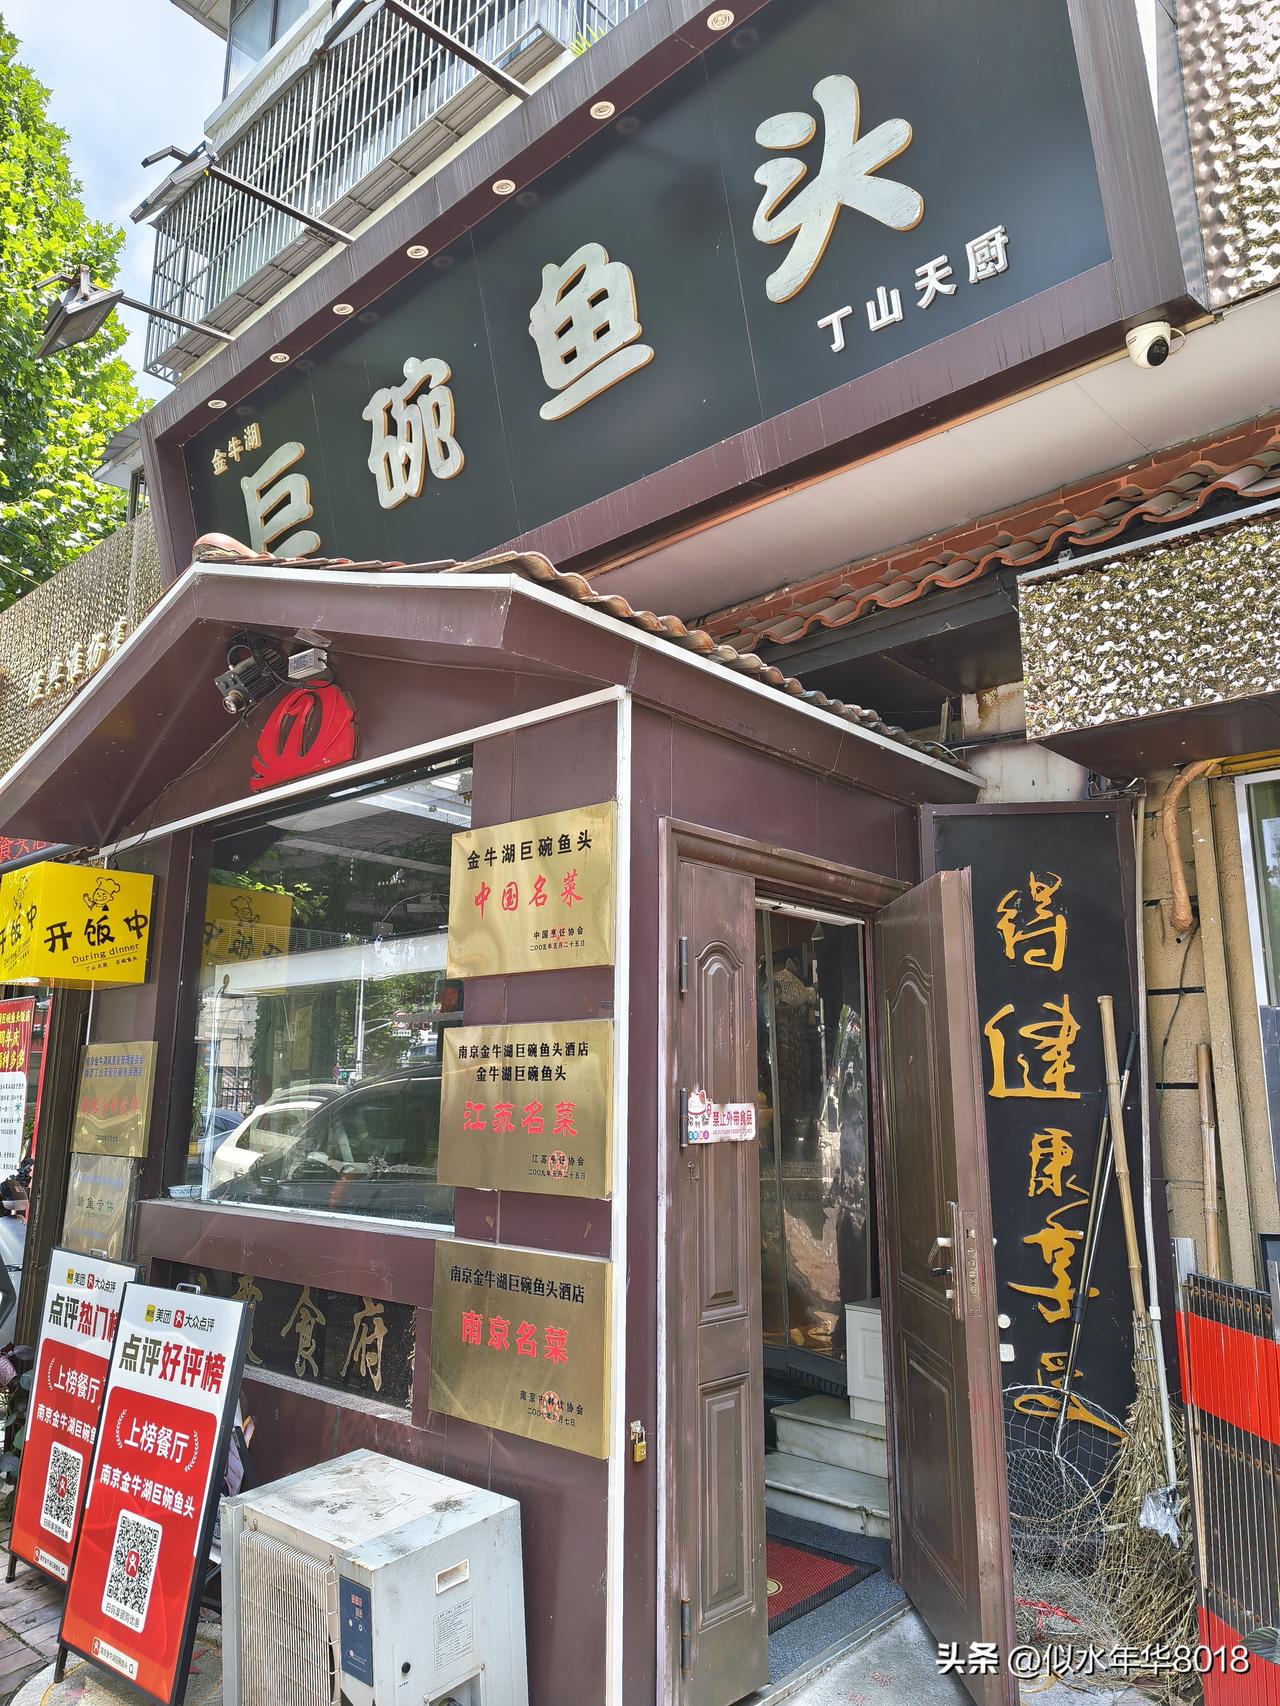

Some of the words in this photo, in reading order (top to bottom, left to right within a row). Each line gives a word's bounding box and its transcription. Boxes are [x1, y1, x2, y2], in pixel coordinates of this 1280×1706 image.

[817, 225, 1009, 352] 丁山天厨
[240, 74, 924, 558] 巨碗鱼头
[211, 422, 262, 476] 金牛湖
[467, 829, 592, 870] 金牛湖巨碗鱼头
[474, 868, 583, 919] 中国名菜
[44, 909, 148, 953] 开饭中
[72, 950, 106, 964] During
[109, 944, 139, 957] dinner
[458, 1042, 589, 1059] 南京金牛湖巨碗鱼头酒店
[476, 1065, 566, 1082] 金牛湖巨碗鱼头
[463, 1099, 578, 1136] 江苏名菜
[713, 1110, 752, 1127] 禁止外带食品
[95, 1277, 117, 1293] 大众点评
[450, 1264, 585, 1304] 南京金牛湖巨碗鱼头酒店
[156, 1308, 172, 1324] 美团
[184, 1314, 215, 1332] 大众点评
[461, 1310, 569, 1364] 南京名菜
[53, 1364, 101, 1404] 上榜餐厅
[119, 1333, 226, 1394] 点评好评榜
[124, 1417, 190, 1463] 上榜餐厅
[100, 1464, 195, 1519] 南京金牛湖巨碗鱼头
